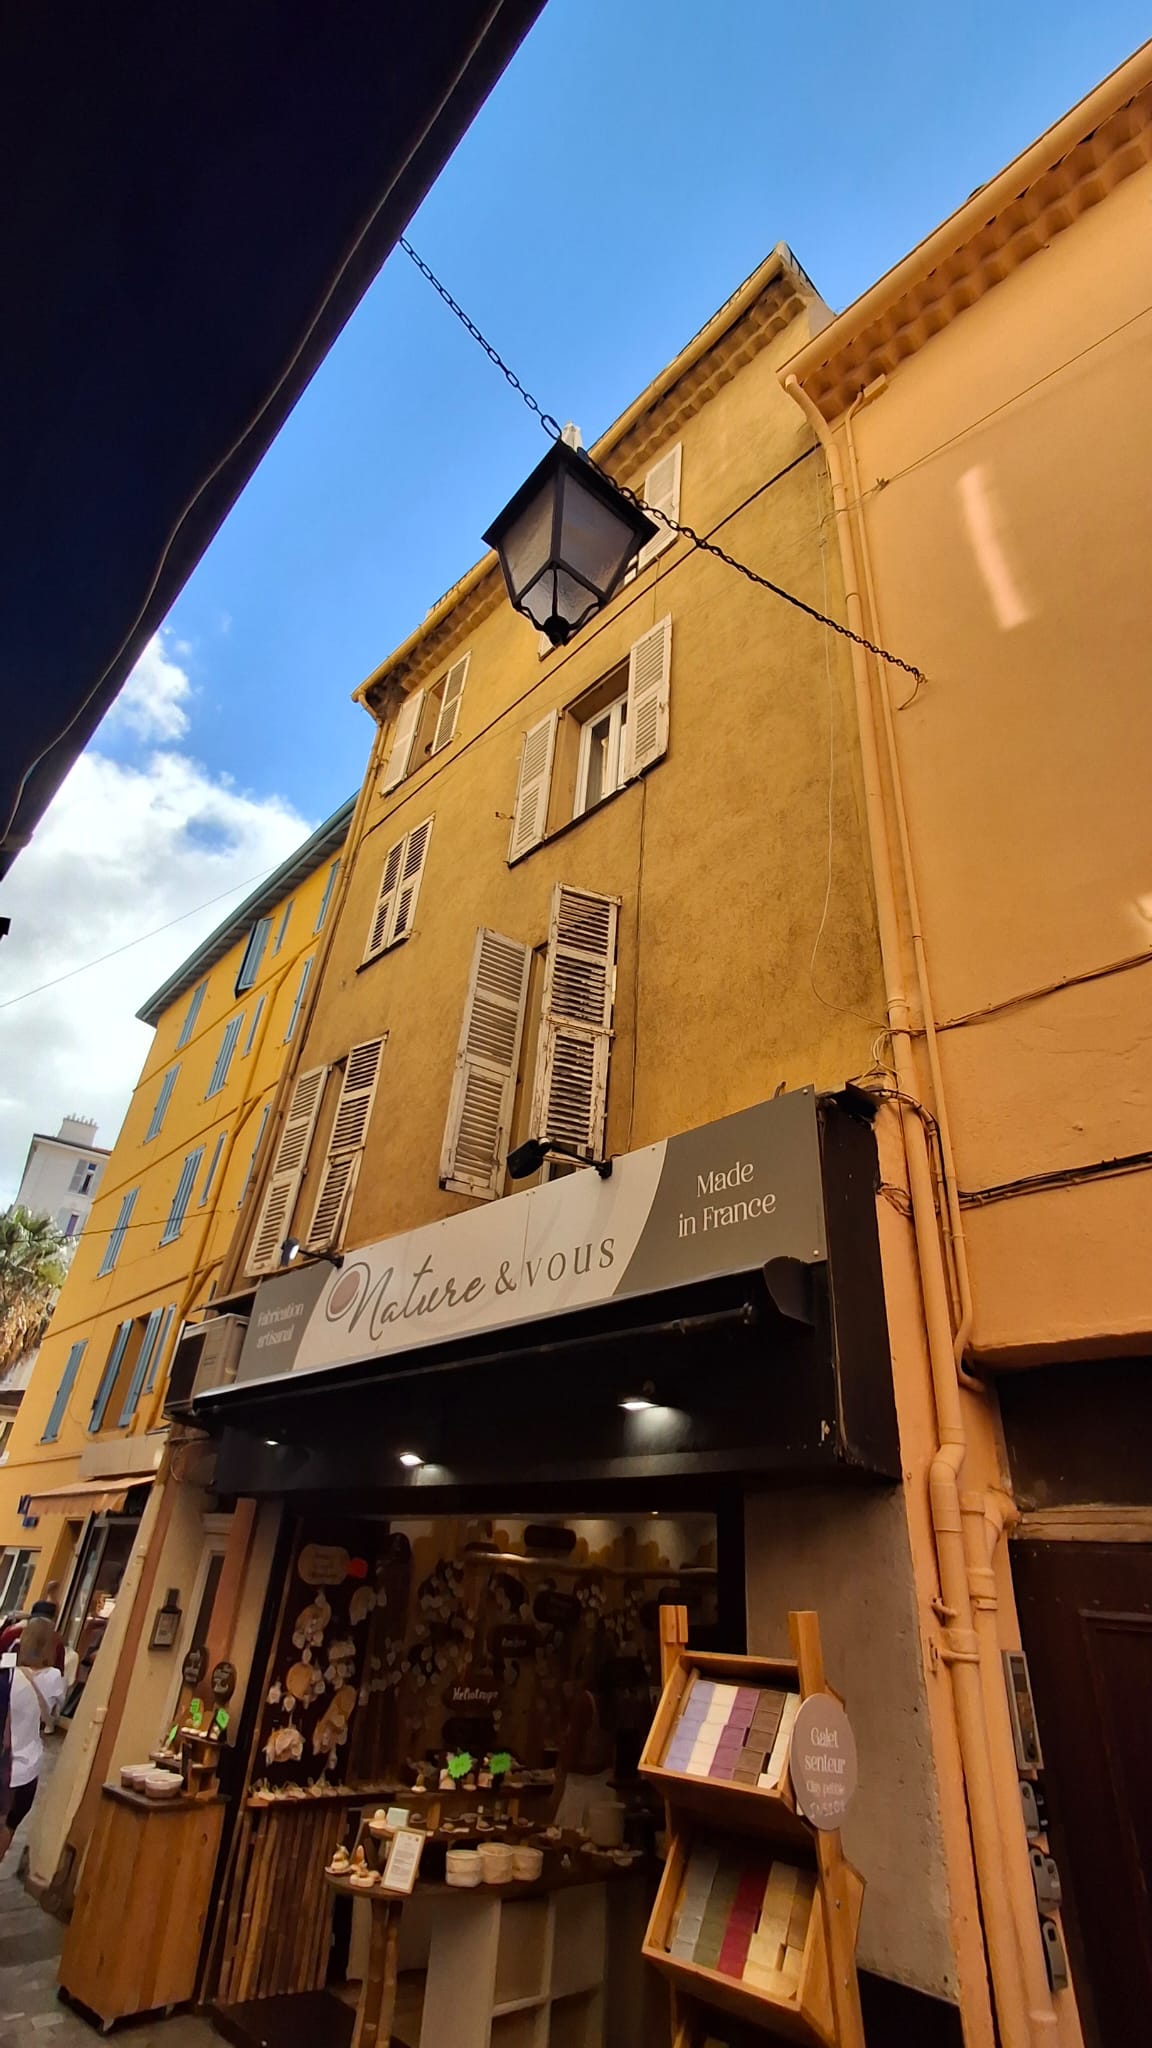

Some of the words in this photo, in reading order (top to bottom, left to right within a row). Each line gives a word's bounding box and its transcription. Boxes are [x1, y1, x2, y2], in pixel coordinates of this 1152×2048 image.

[697, 1161, 754, 1197] Made
[679, 1213, 696, 1238] in
[703, 1193, 776, 1231] France
[325, 1254, 486, 1341] Nature
[495, 1260, 517, 1294] &
[257, 1303, 304, 1328] Fabrication
[810, 1727, 839, 1749] Galet
[804, 1754, 846, 1775] senteur
